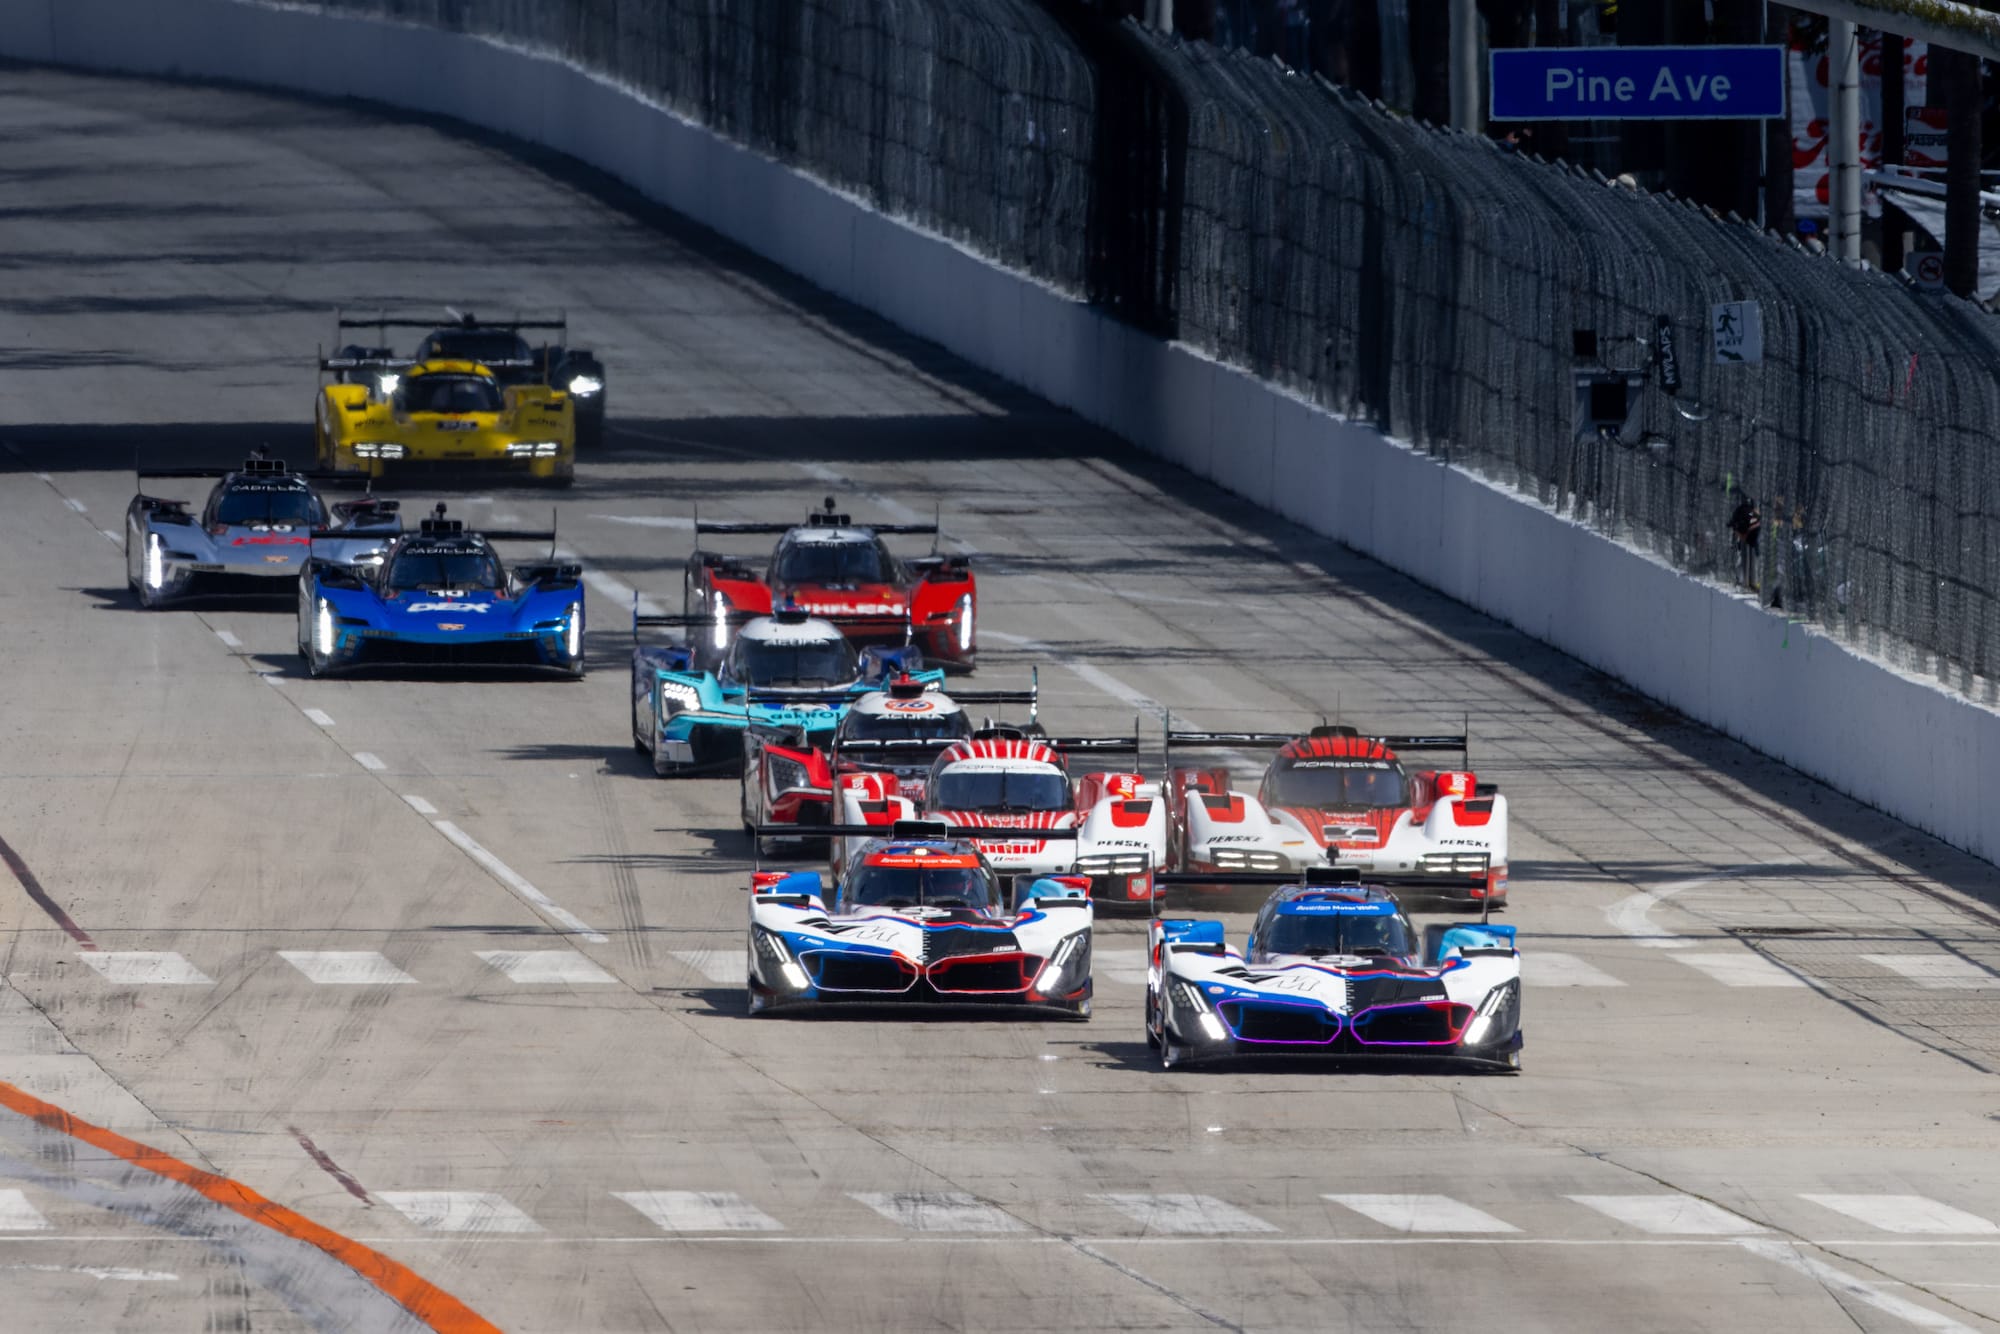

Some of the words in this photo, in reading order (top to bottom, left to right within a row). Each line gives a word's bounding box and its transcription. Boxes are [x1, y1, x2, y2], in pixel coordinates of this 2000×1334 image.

[1546, 67, 1636, 102] Pine
[1649, 66, 1732, 102] Ave
[1908, 135, 1947, 146] PASSPO
[1716, 338, 1742, 347] EXIT
[1662, 326, 1676, 385] MYLAPS
[406, 547, 485, 555] CADILLAC
[406, 602, 492, 613] DEX
[875, 713, 945, 721] ACURA
[1293, 761, 1390, 770] PORSCHE
[1097, 840, 1151, 849] PENSKE
[1206, 835, 1263, 845] PENSKE
[1440, 839, 1491, 848] PENSKE
